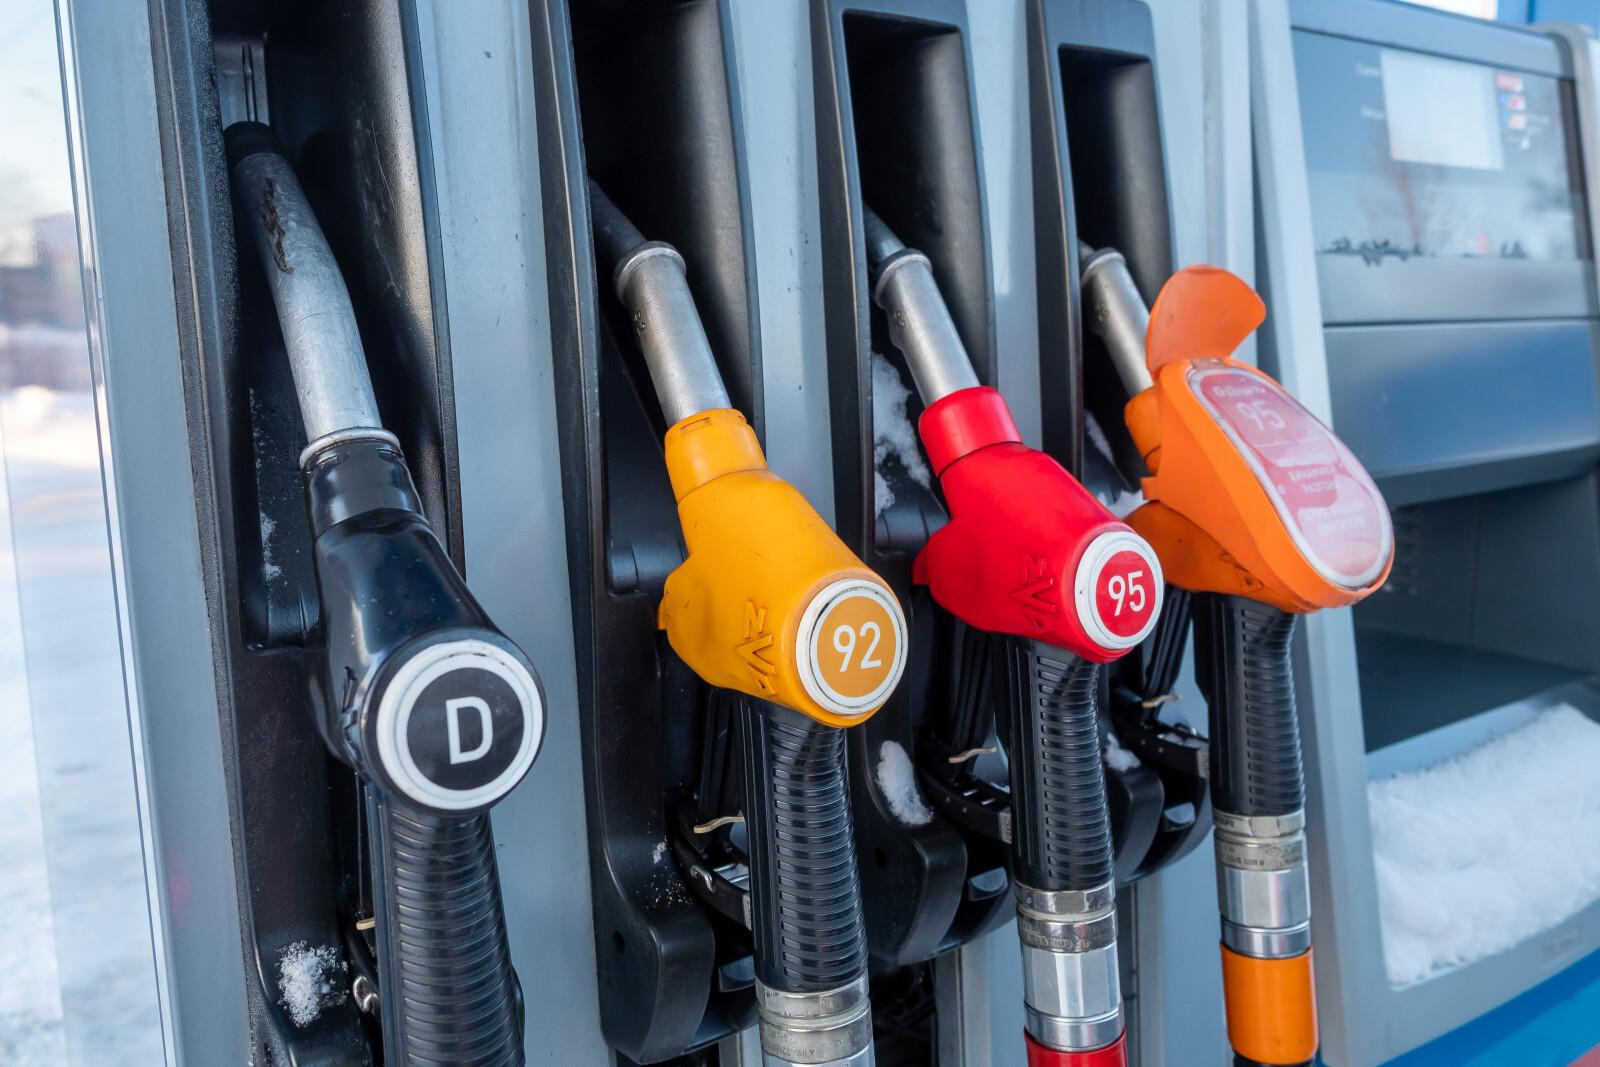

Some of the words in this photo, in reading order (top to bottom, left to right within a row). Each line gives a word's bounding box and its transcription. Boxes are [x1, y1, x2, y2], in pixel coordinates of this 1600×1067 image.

[1235, 400, 1286, 431] 95
[1108, 570, 1146, 617] 95
[832, 620, 882, 673] 92
[445, 695, 494, 765] D
